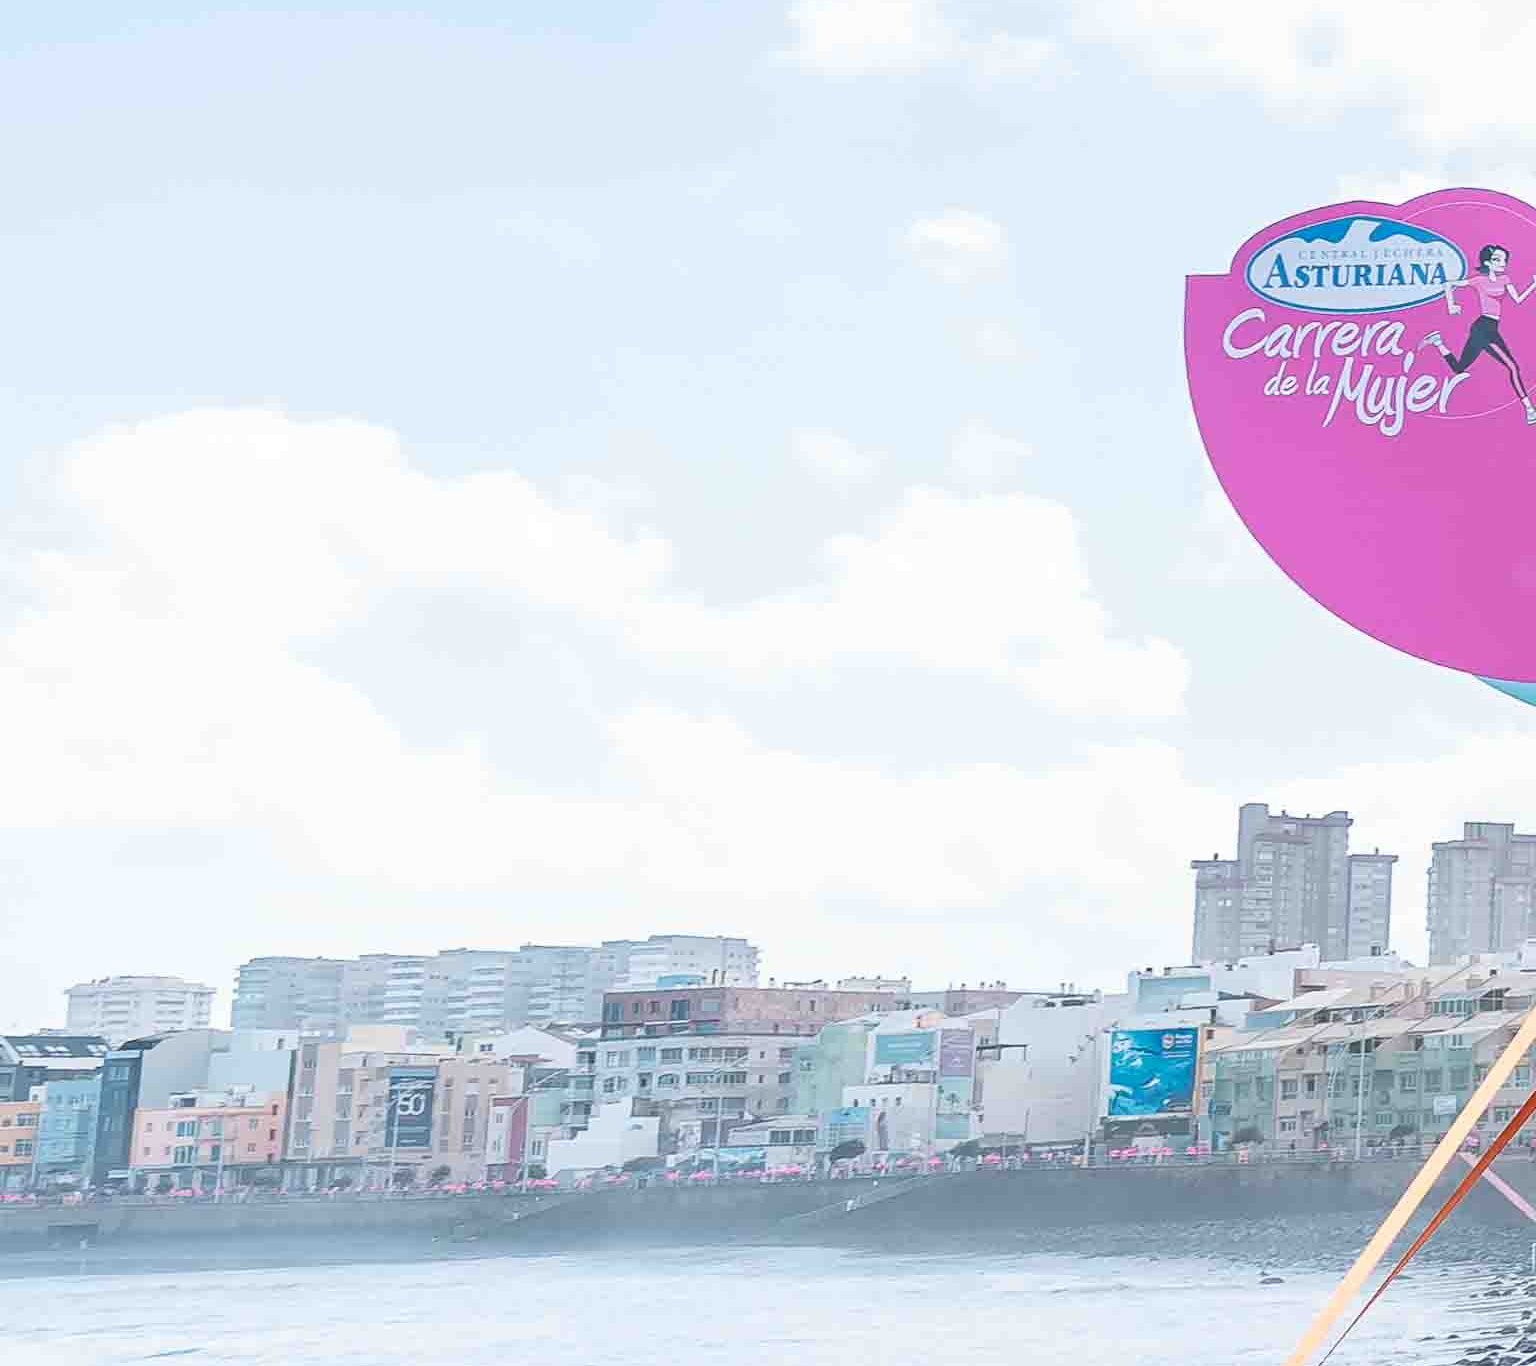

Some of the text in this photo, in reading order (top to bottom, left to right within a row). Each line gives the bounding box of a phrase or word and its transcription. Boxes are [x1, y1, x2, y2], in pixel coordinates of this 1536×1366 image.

[1263, 252, 1448, 288] ASTURIANA
[1223, 308, 1405, 358] Carrera
[1264, 349, 1472, 437] de la Mujer
